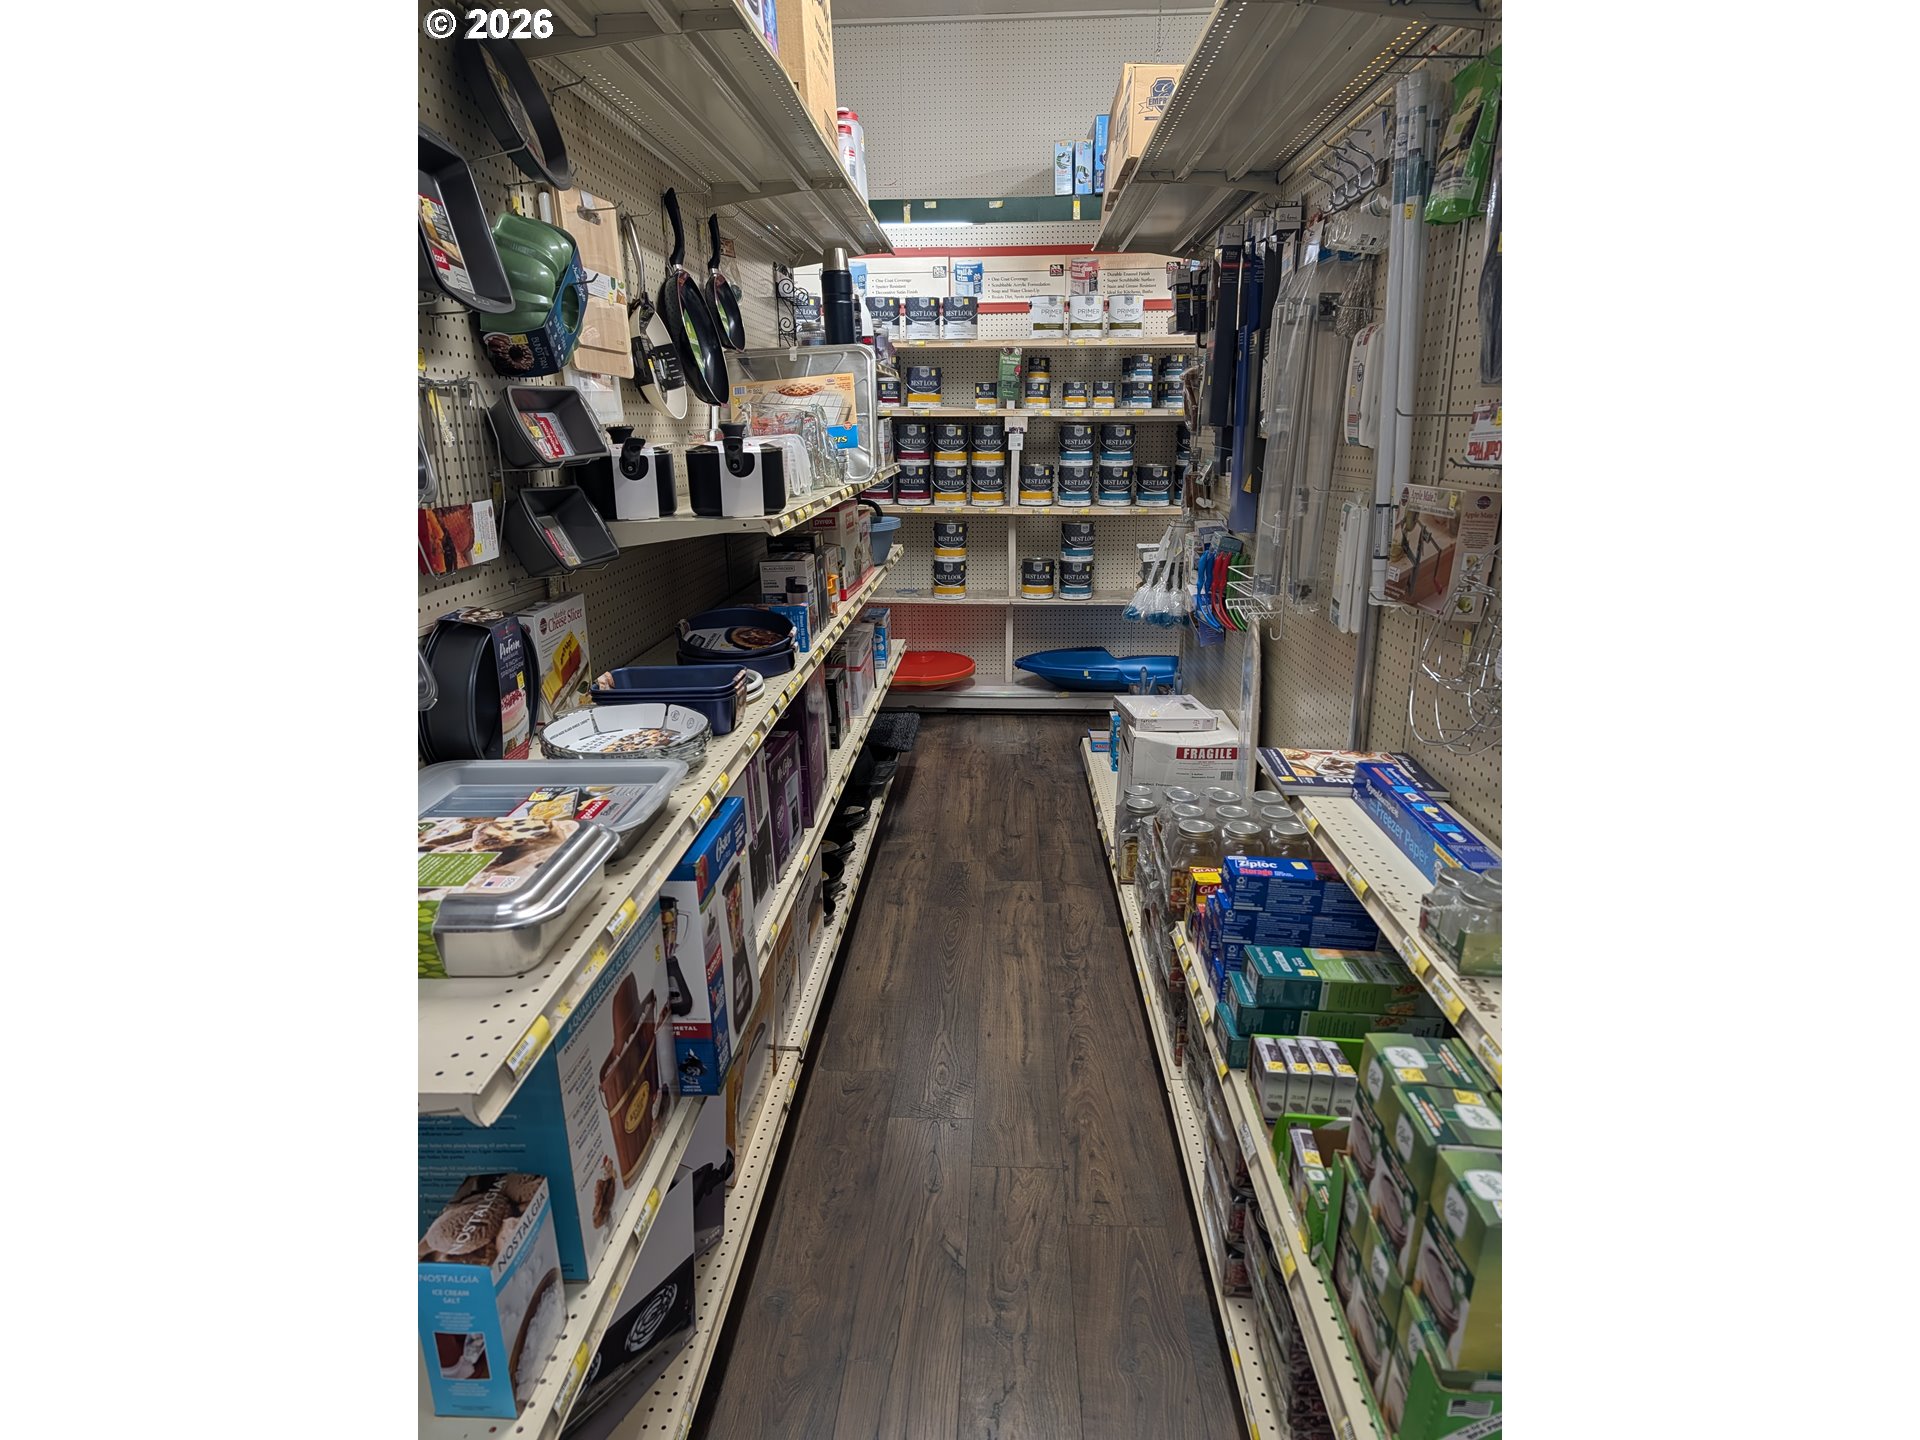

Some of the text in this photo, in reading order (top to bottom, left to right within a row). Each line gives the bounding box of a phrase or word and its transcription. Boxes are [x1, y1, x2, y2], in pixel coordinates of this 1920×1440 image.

[910, 379, 939, 387] BEST LOOK
[989, 478, 1003, 486] LOOK
[814, 518, 834, 526] pyrex
[548, 607, 583, 633] Cheese Slicer
[1183, 747, 1233, 759] FRAGILE
[1374, 801, 1430, 864] Freezer Paper
[716, 829, 732, 863] Oster
[1238, 860, 1278, 869] Ziploc
[1239, 868, 1273, 877] Storage
[591, 964, 619, 1002] ELECTRIC
[449, 1175, 508, 1255] NOSTALGIA
[497, 1190, 546, 1273] NOSTALGIA
[418, 1273, 479, 1285] NOSTALGIA
[432, 1289, 470, 1298] ICE CREAM
[442, 1297, 461, 1305] SALT
